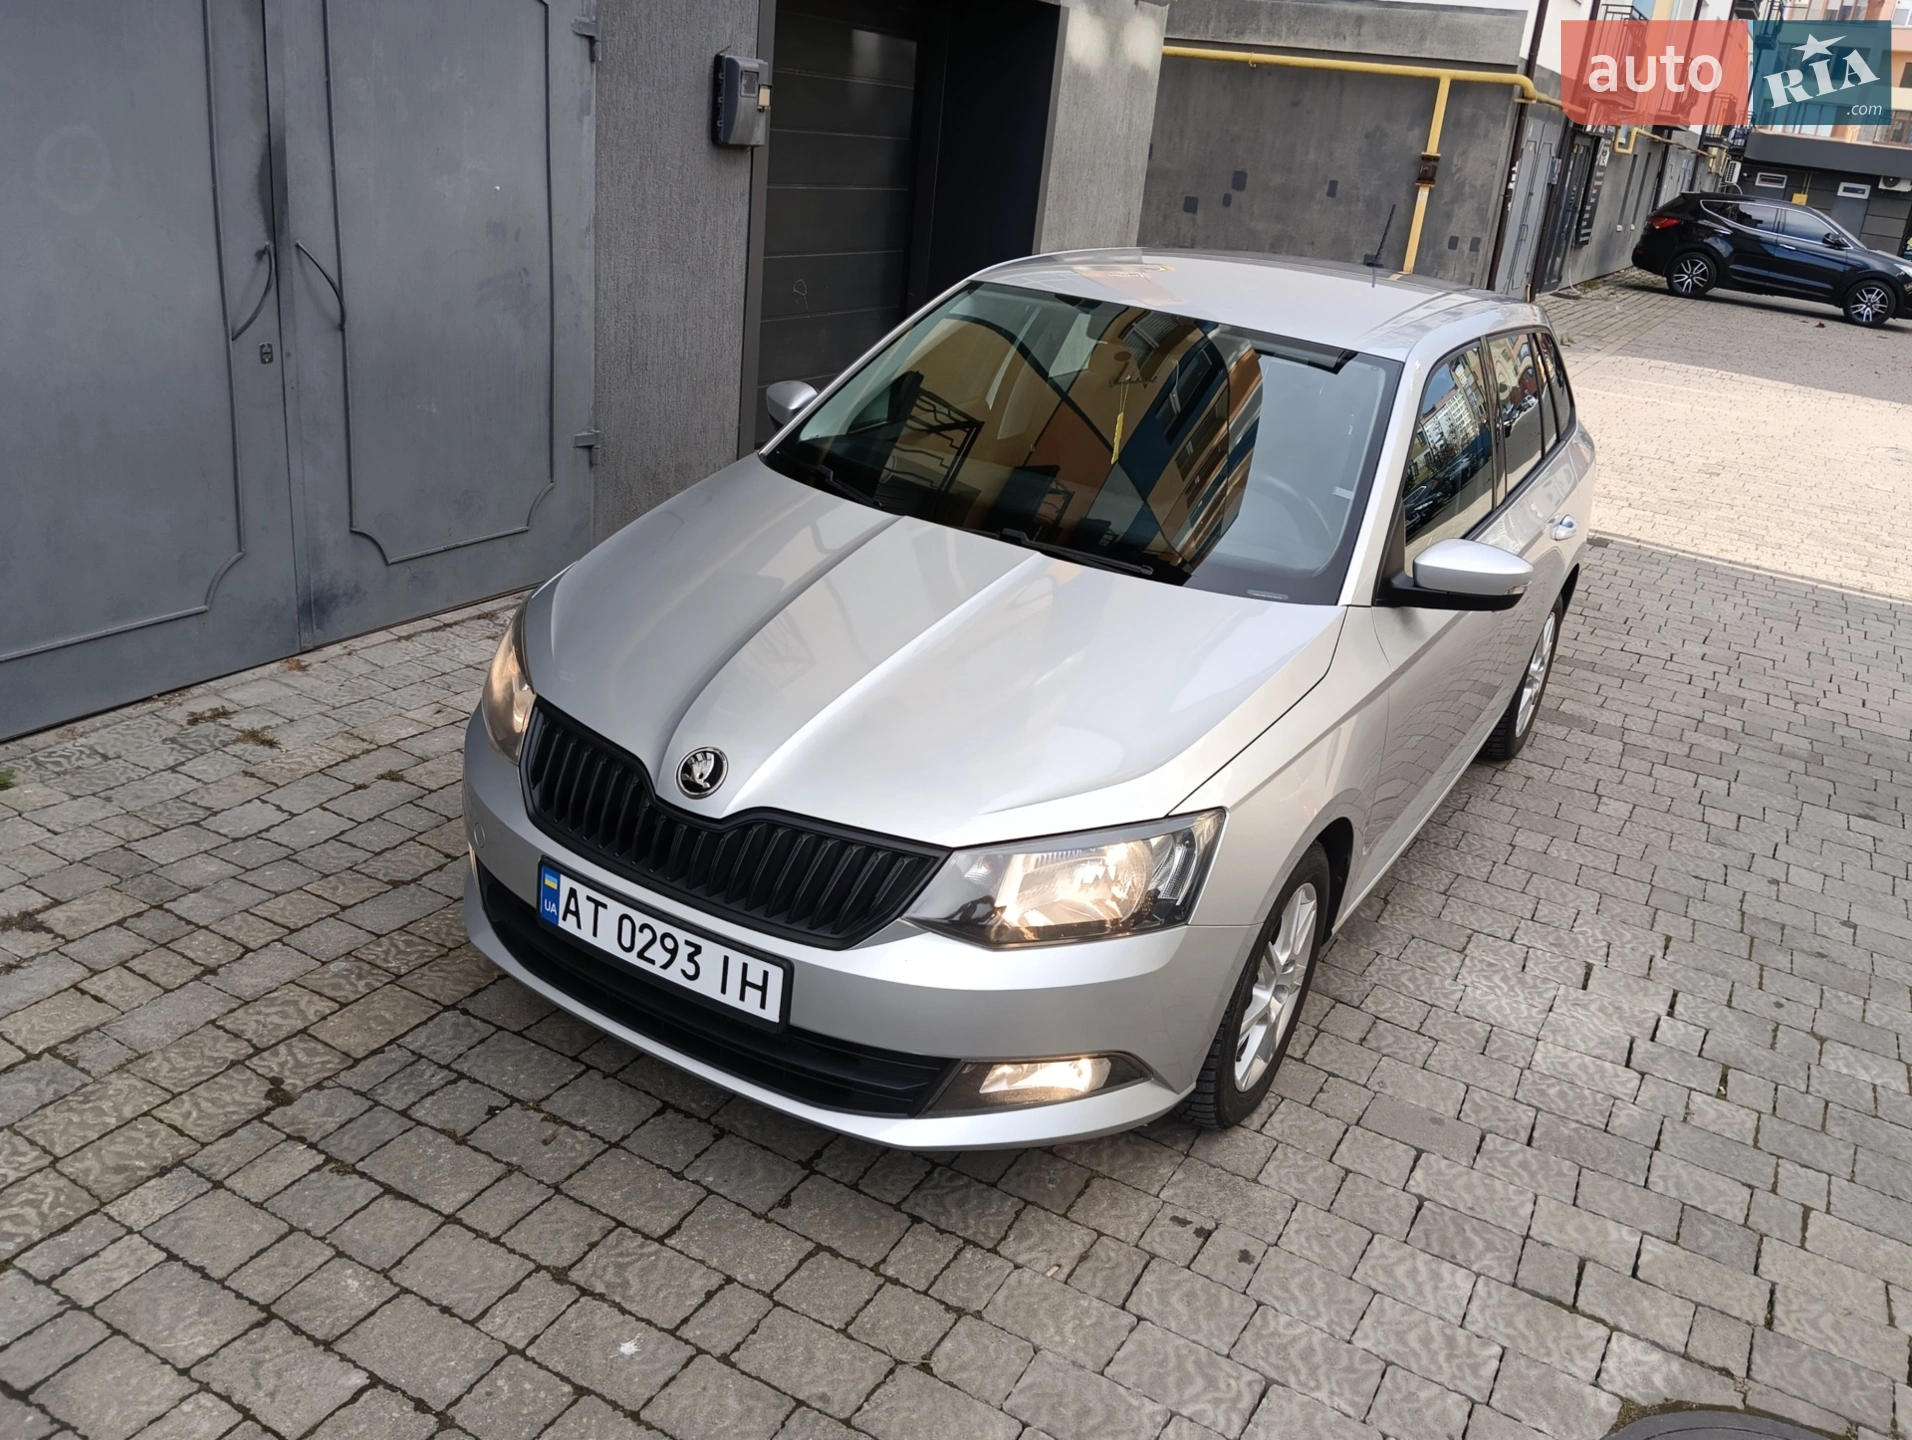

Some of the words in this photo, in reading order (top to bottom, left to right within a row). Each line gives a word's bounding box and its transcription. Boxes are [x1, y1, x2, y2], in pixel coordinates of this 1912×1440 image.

[544, 898, 558, 916] UA
[562, 886, 608, 939] AT
[617, 913, 703, 982] 0293
[720, 954, 769, 1011] IH
